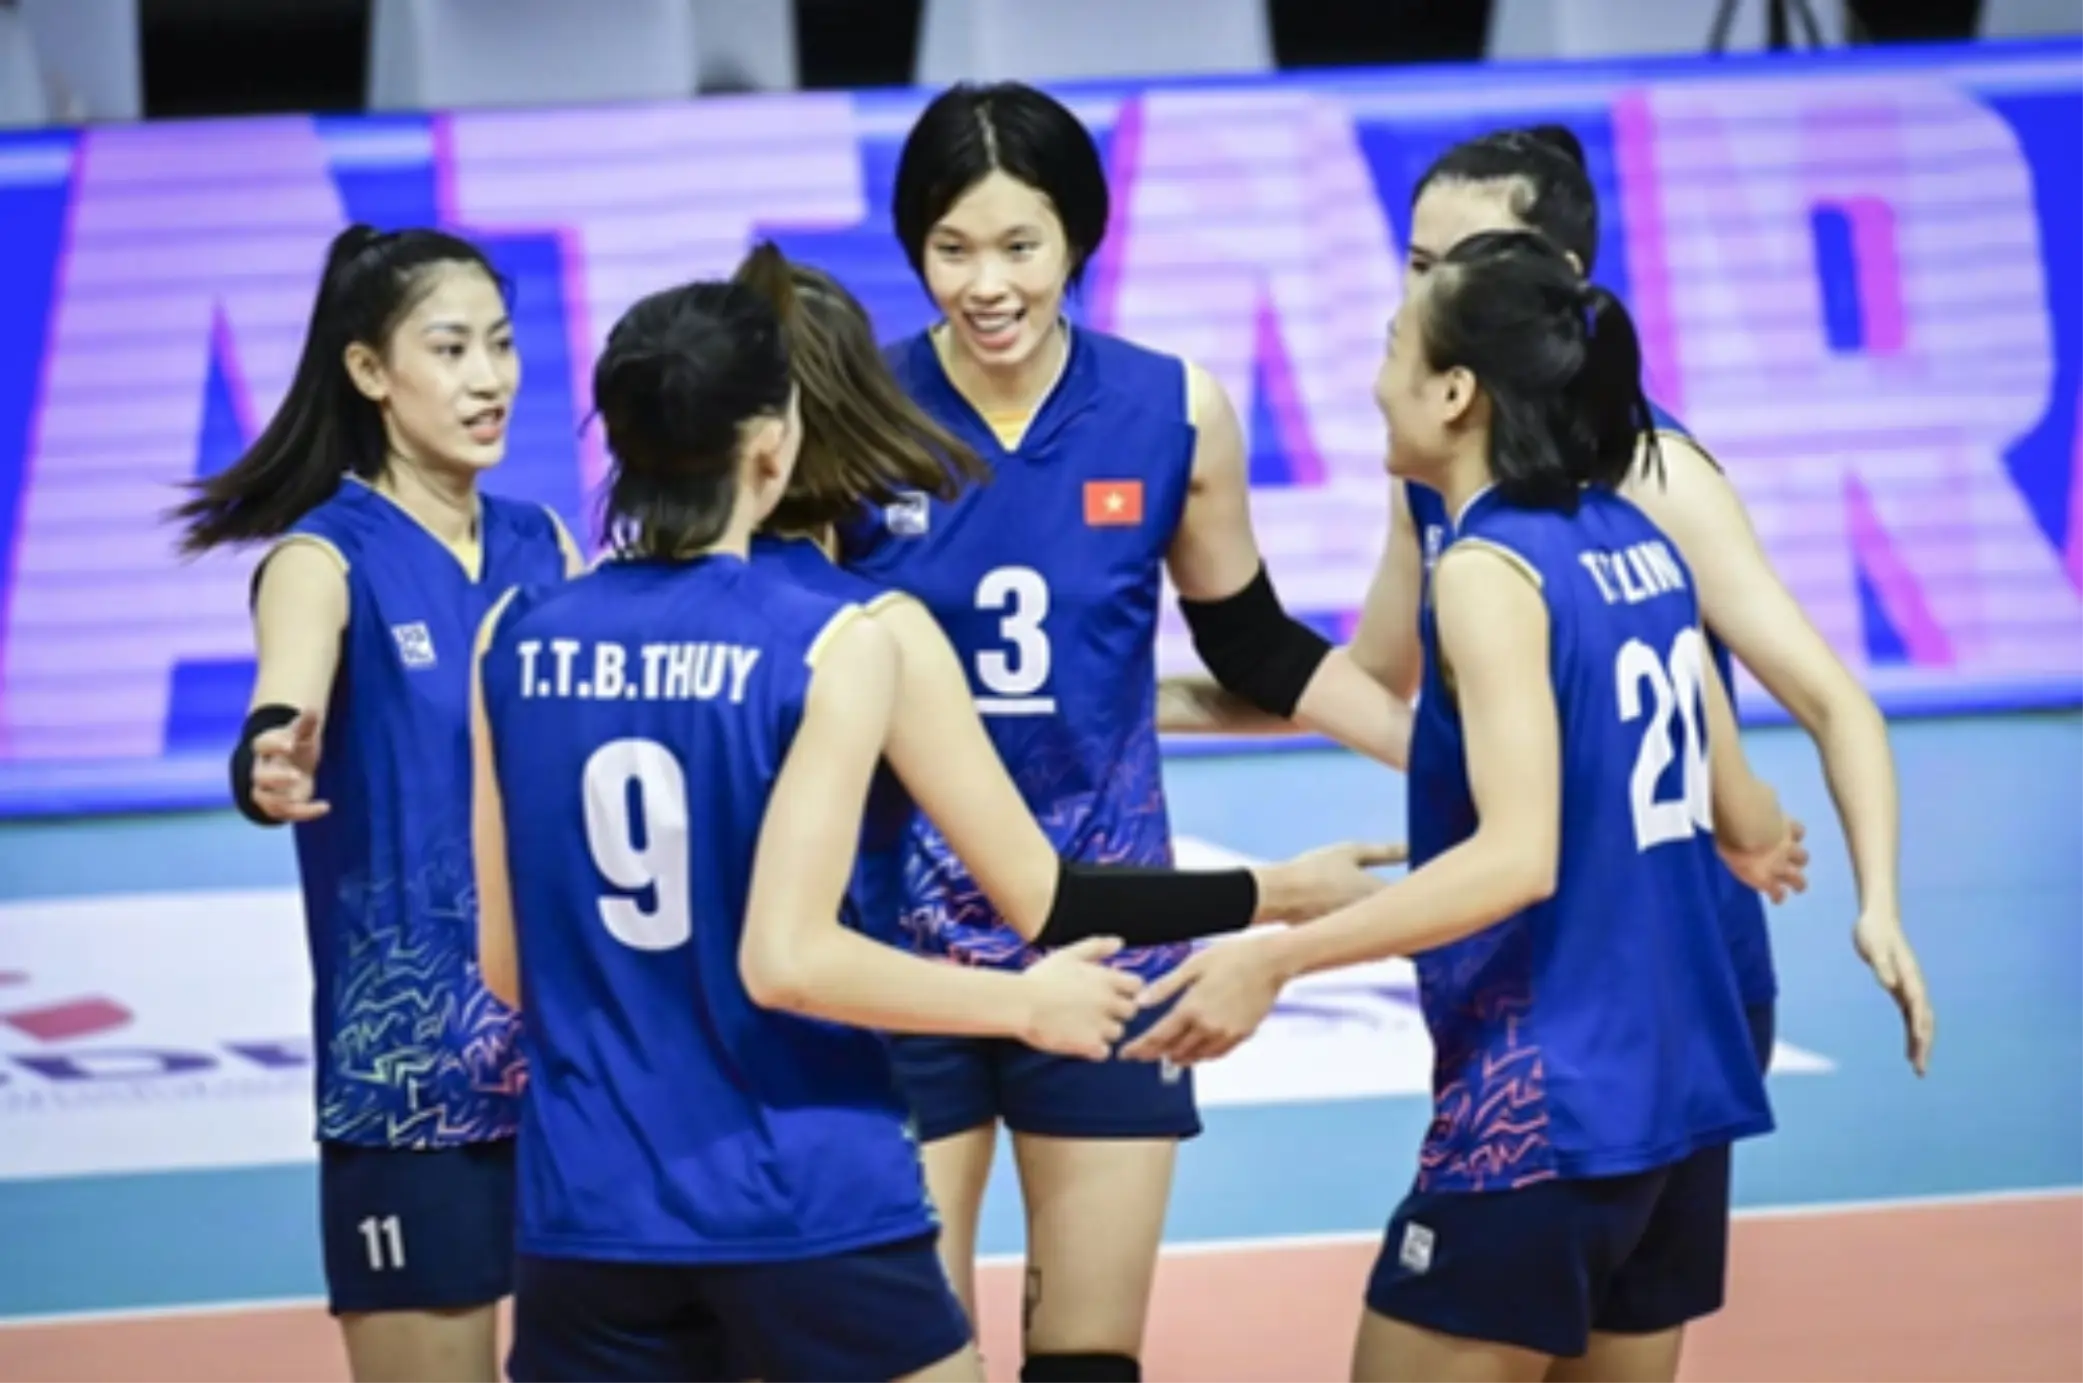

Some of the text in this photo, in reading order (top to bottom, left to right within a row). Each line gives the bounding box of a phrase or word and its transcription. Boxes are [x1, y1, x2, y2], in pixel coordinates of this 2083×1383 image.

[517, 639, 761, 703] T.T.B.THUY
[974, 565, 1050, 696] 3
[1615, 625, 1713, 853] 20
[582, 737, 692, 951] 9
[358, 1215, 404, 1269] 11
